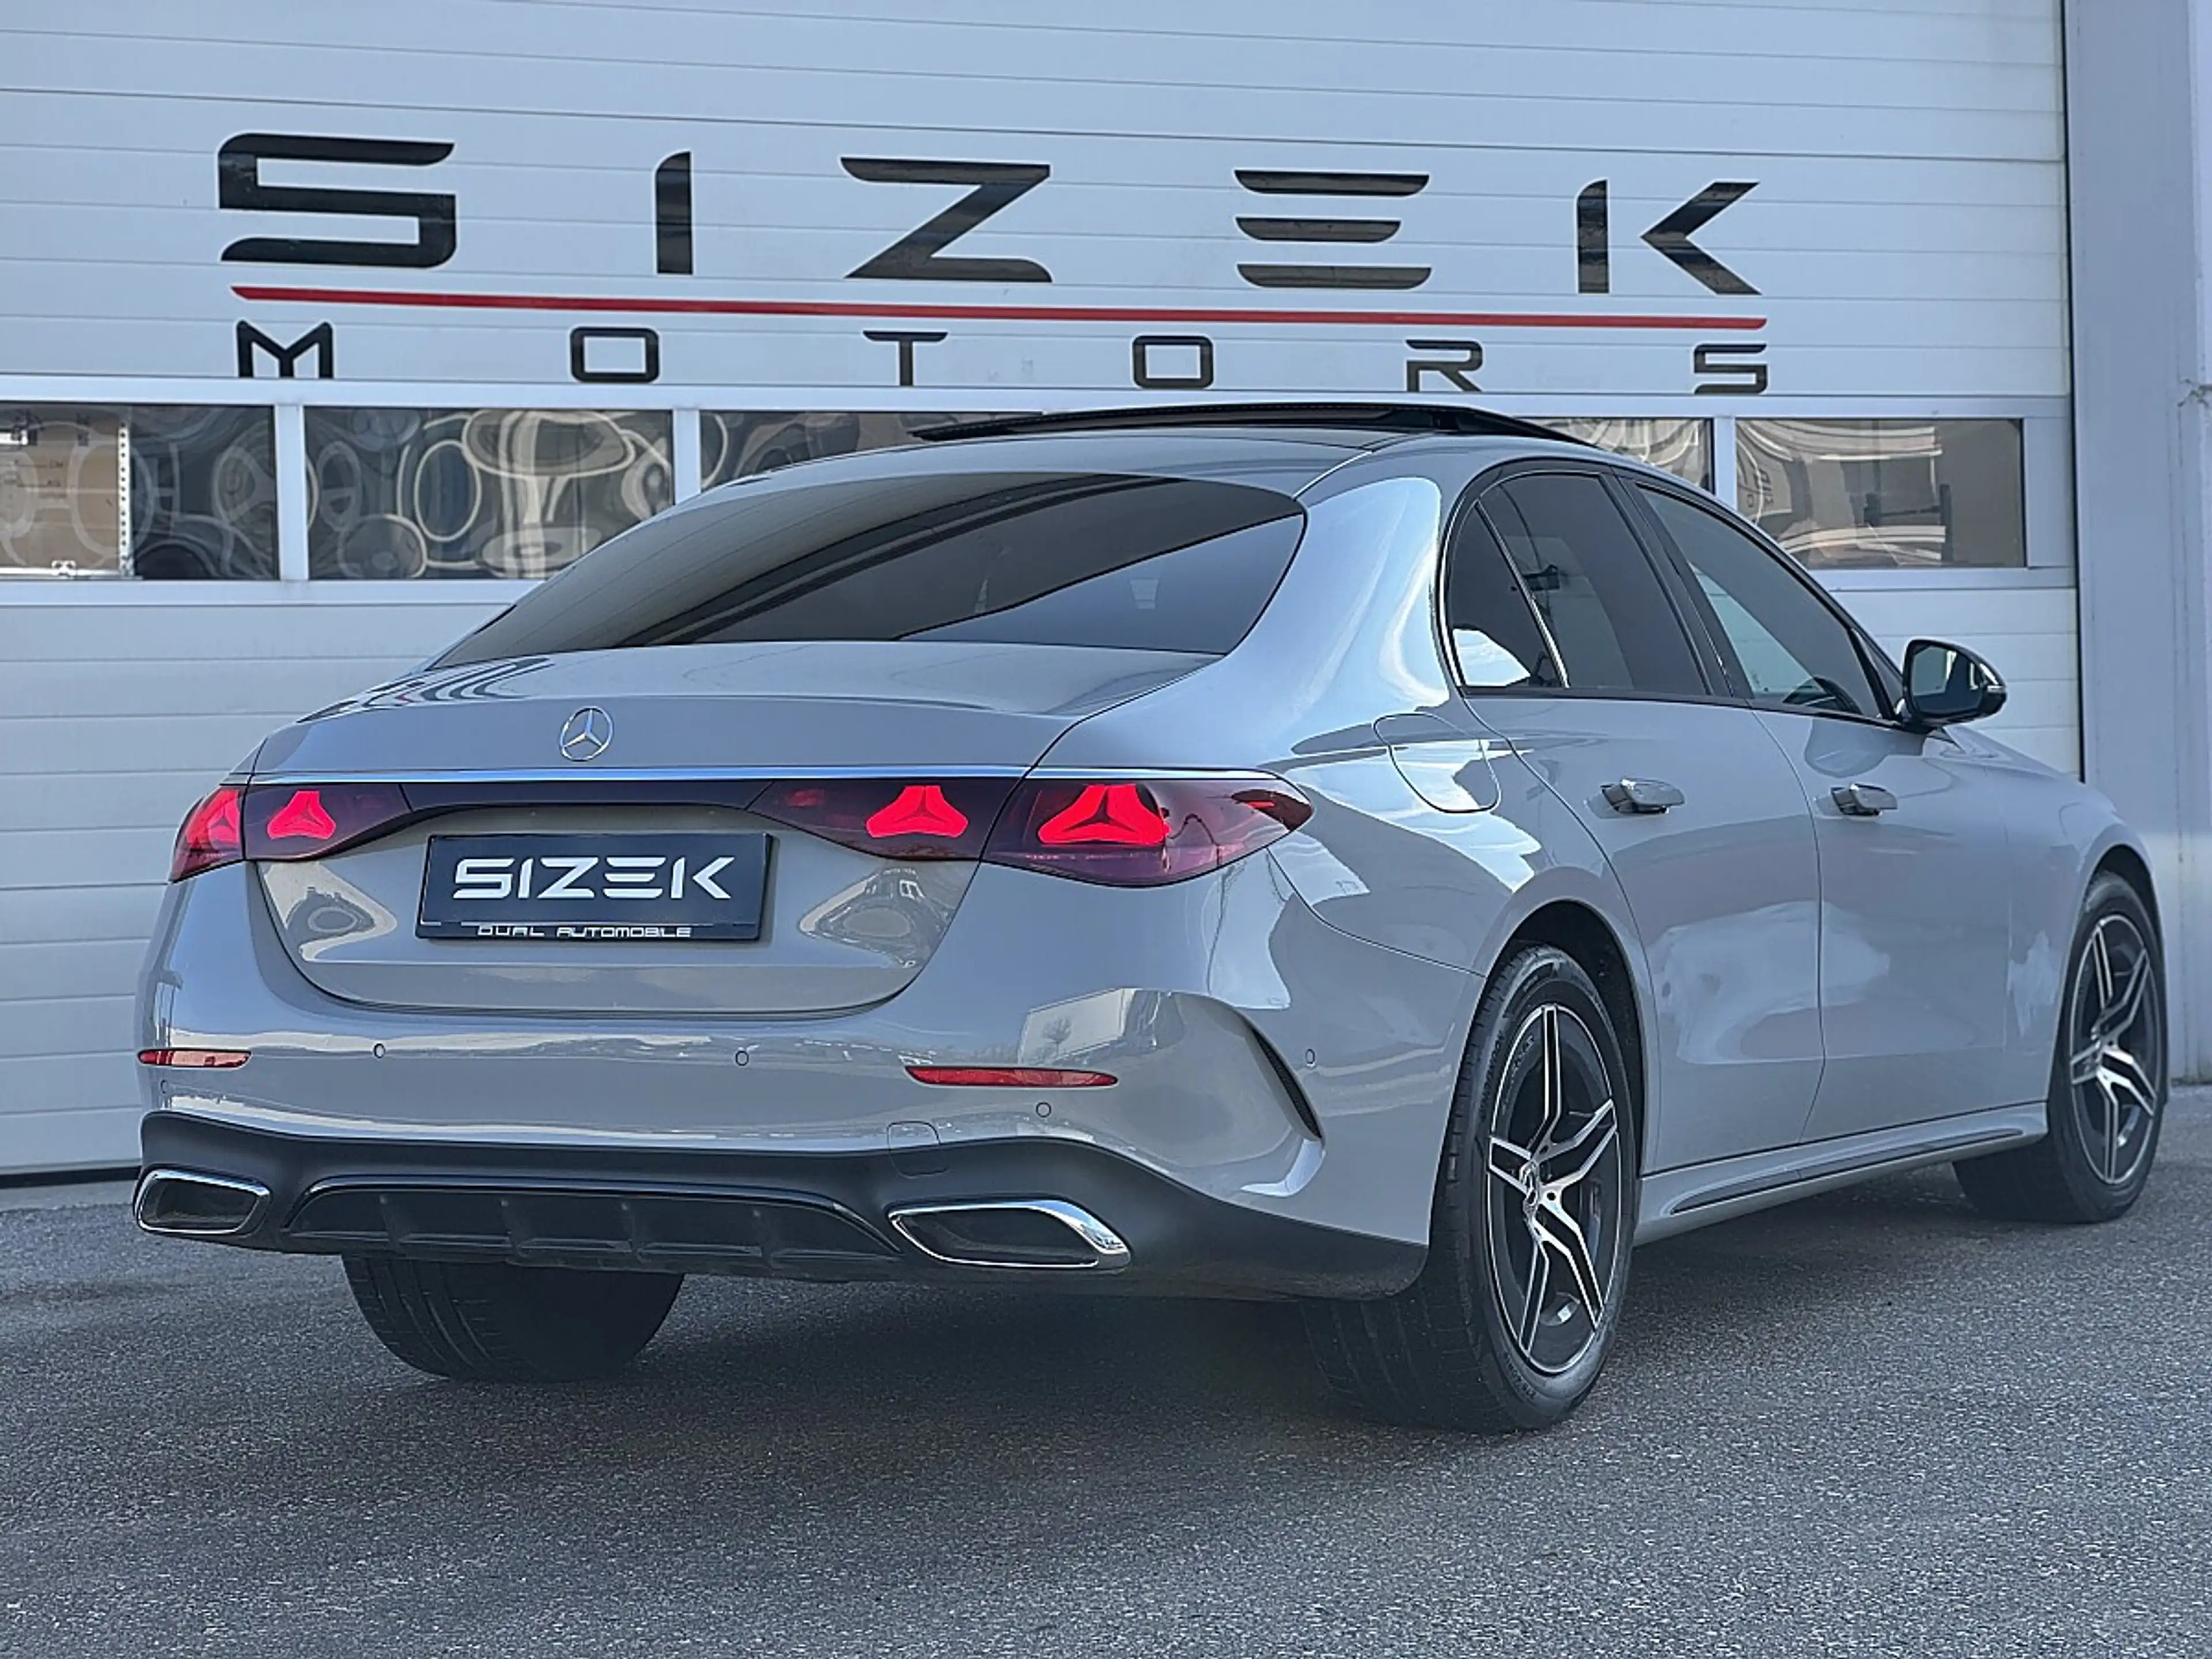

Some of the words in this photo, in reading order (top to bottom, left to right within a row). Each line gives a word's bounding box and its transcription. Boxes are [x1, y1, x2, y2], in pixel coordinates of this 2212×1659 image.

[217, 132, 1762, 296] SIZEK
[236, 320, 1768, 392] MOTORS
[453, 857, 735, 899] SIZEK
[478, 925, 545, 937] DUAL
[556, 926, 691, 938] AUTOMOBILE
